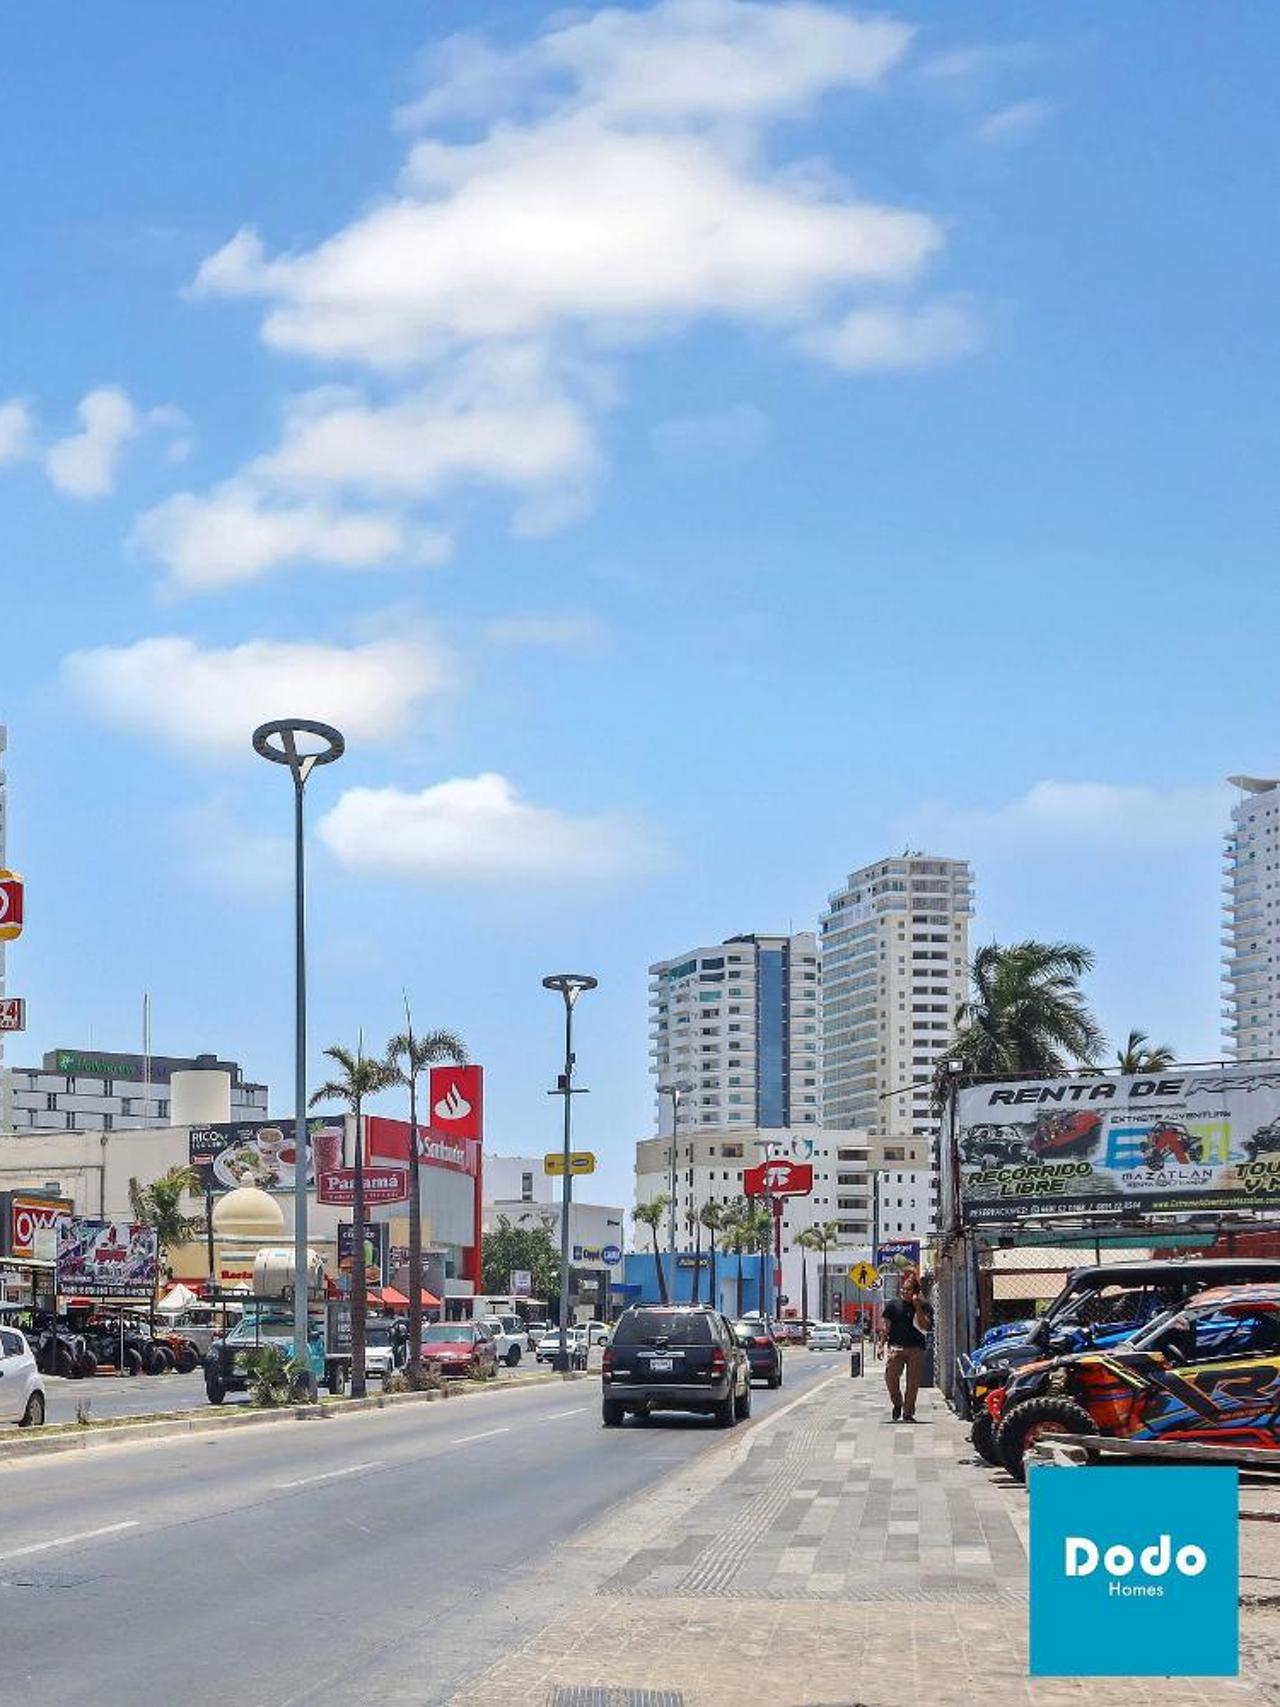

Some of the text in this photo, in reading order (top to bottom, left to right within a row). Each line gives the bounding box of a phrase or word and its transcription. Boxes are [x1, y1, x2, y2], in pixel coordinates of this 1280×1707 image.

[988, 1083, 1117, 1106] RENTA
[1129, 1079, 1185, 1098] DE
[969, 1162, 1093, 1185] RECORRIDO
[1000, 1179, 1066, 1198] LIBRE
